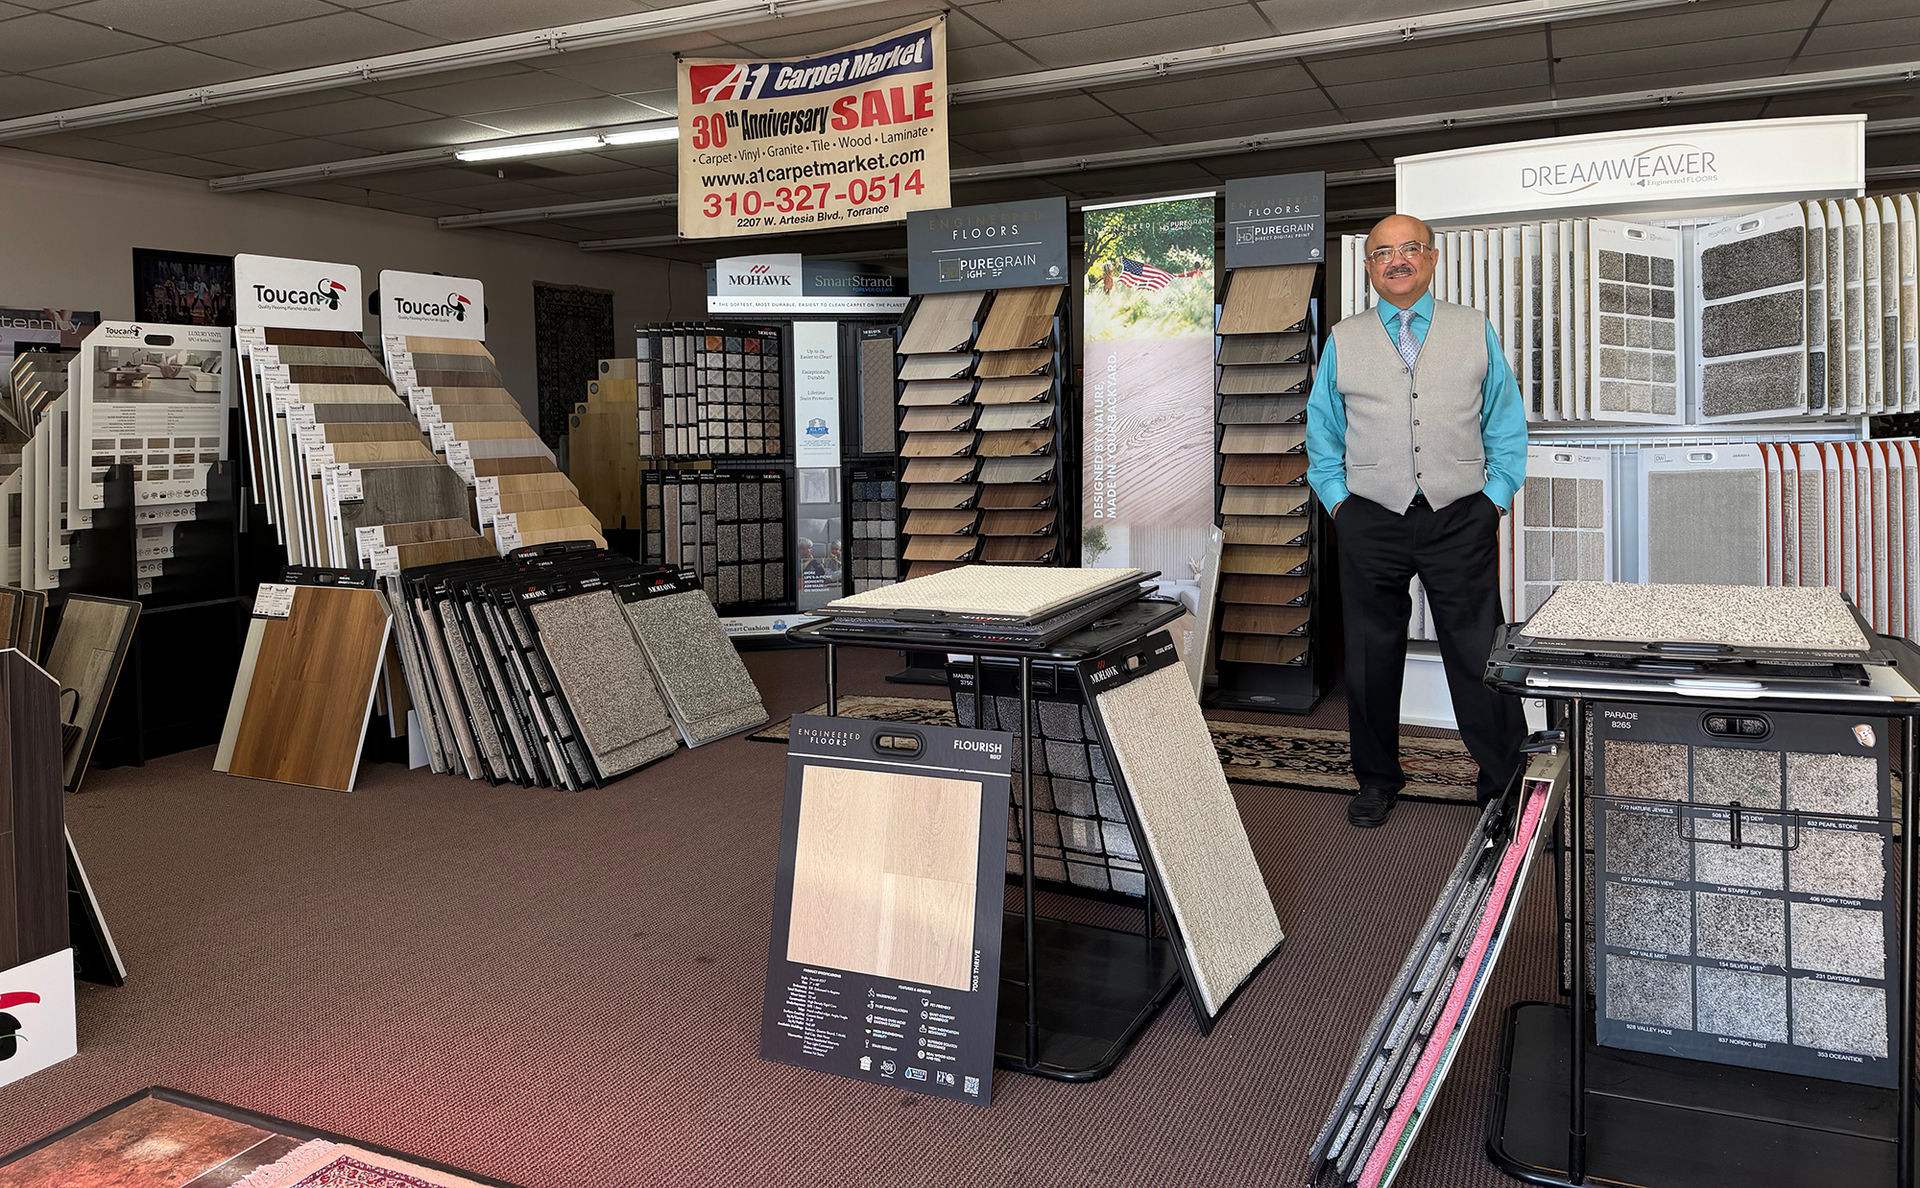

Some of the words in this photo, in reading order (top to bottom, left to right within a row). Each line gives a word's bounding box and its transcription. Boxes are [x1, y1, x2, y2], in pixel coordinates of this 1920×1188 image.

[774, 58, 850, 91] Carpet
[848, 37, 926, 79] Market
[741, 105, 829, 141] Anniversary
[831, 82, 934, 131] SALE
[698, 153, 732, 167] Carpet
[738, 149, 761, 163] Vinyl
[767, 144, 804, 157] Granite
[811, 139, 830, 152] Tile
[838, 134, 872, 148] Wood
[881, 128, 928, 144] Laminate
[701, 149, 925, 187] www.a1carpetmarket.com
[1521, 151, 1717, 188] DREAMWEAVER
[1647, 177, 1686, 187] Engineered
[1686, 174, 1718, 184] FLOORS
[702, 169, 925, 218] 310-327-0514
[1231, 195, 1319, 210] ENGINEERED
[737, 218, 761, 228] 2207
[764, 216, 777, 226] W.
[779, 213, 814, 225] Artesia
[816, 211, 844, 223] Blvd.,
[847, 204, 889, 218] Torrance
[1248, 205, 1300, 217] FLOORS
[929, 210, 1042, 230] ENGINEERED
[1170, 218, 1210, 228] PUREGRAIN
[952, 224, 1020, 240] FLOORS
[1254, 223, 1314, 235] PUREGRAIN
[960, 254, 1036, 271] PUREGRAIN
[729, 275, 791, 286] MOHAWK
[815, 274, 892, 287] SmartStrand
[253, 284, 320, 305] Toucan
[394, 297, 449, 317] Toucan
[105, 327, 132, 335] Toucan
[1107, 351, 1117, 422] BACKYARD.
[1094, 381, 1105, 434] NATURE,
[1094, 437, 1104, 452] BY
[1107, 426, 1117, 461] YOUR
[1107, 464, 1117, 475] IN
[1094, 454, 1104, 519] DESIGNED
[1107, 480, 1117, 519] MADE
[1089, 665, 1119, 685] MOHAWK
[1604, 711, 1638, 720] PARADE
[1611, 720, 1631, 729] 8265
[798, 729, 860, 741] ENGINEERED
[810, 737, 847, 747] FLOORS
[954, 740, 1002, 753] FLOURISH
[1722, 814, 1750, 822] MONG
[1631, 877, 1659, 886] MOUNTAIN
[1728, 887, 1749, 895] STARRY
[973, 950, 981, 974] THRIVE
[1729, 962, 1749, 970] SILVER
[1827, 974, 1860, 983] DAYDREAM
[1637, 1025, 1657, 1033] VALLEY
[1729, 1038, 1751, 1046] NORDIC
[1829, 1053, 1863, 1063] OCEANTIDE
